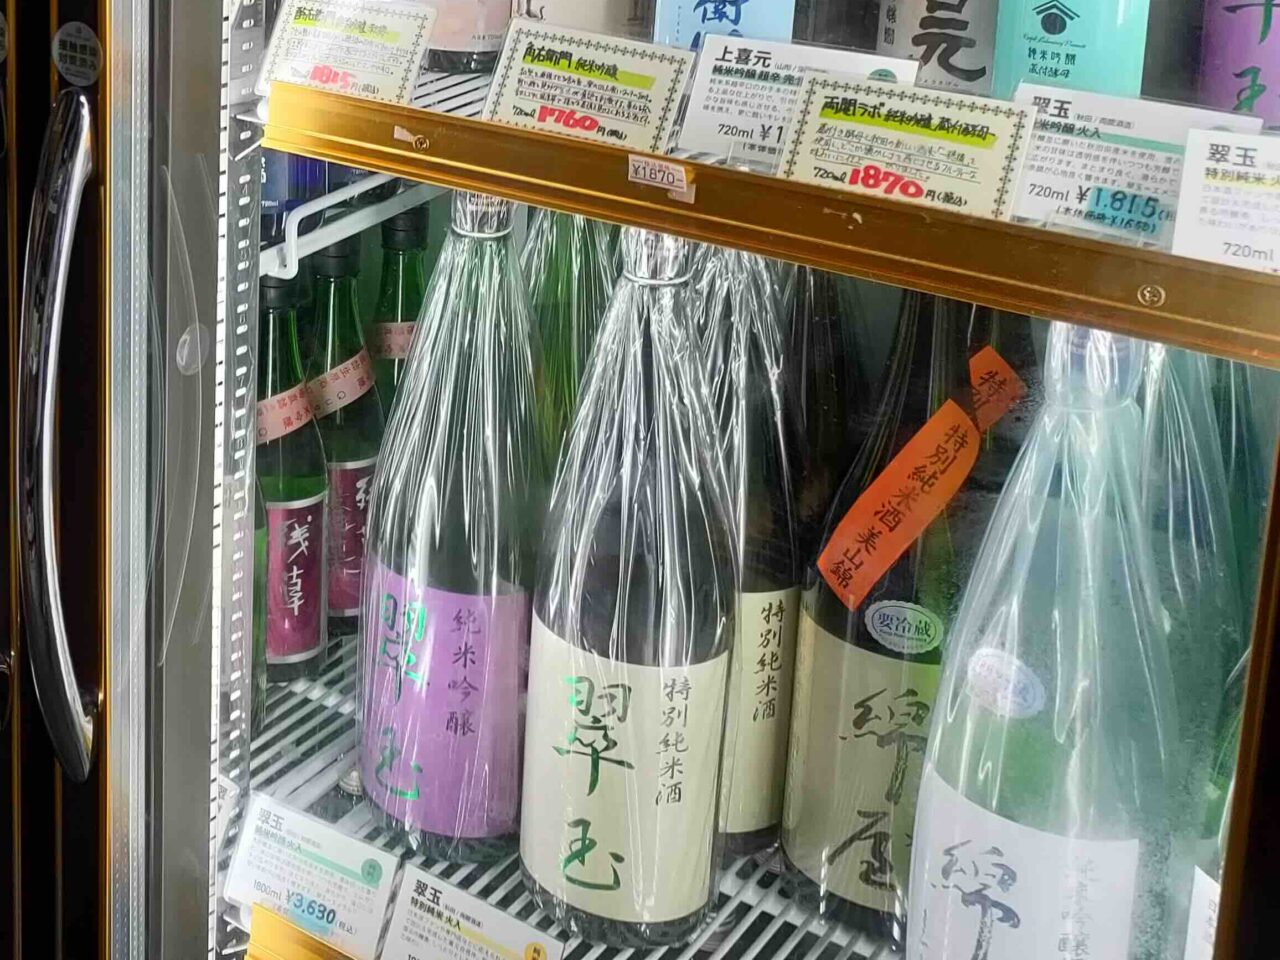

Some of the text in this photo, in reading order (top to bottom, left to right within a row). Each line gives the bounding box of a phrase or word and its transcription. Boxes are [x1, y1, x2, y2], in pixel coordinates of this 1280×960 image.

[714, 44, 773, 70] 上喜元
[717, 123, 754, 140] 720ml
[1206, 142, 1259, 169] 翠玉
[847, 164, 924, 199] 1870
[1027, 183, 1070, 202] 720ml
[1222, 241, 1275, 262] 720ml
[445, 607, 481, 737] 純米吟醸
[752, 597, 786, 723] 特別純米酒
[655, 675, 693, 807] 特別純米酒
[551, 674, 635, 892] 翠玉
[412, 879, 444, 907] 翠玉
